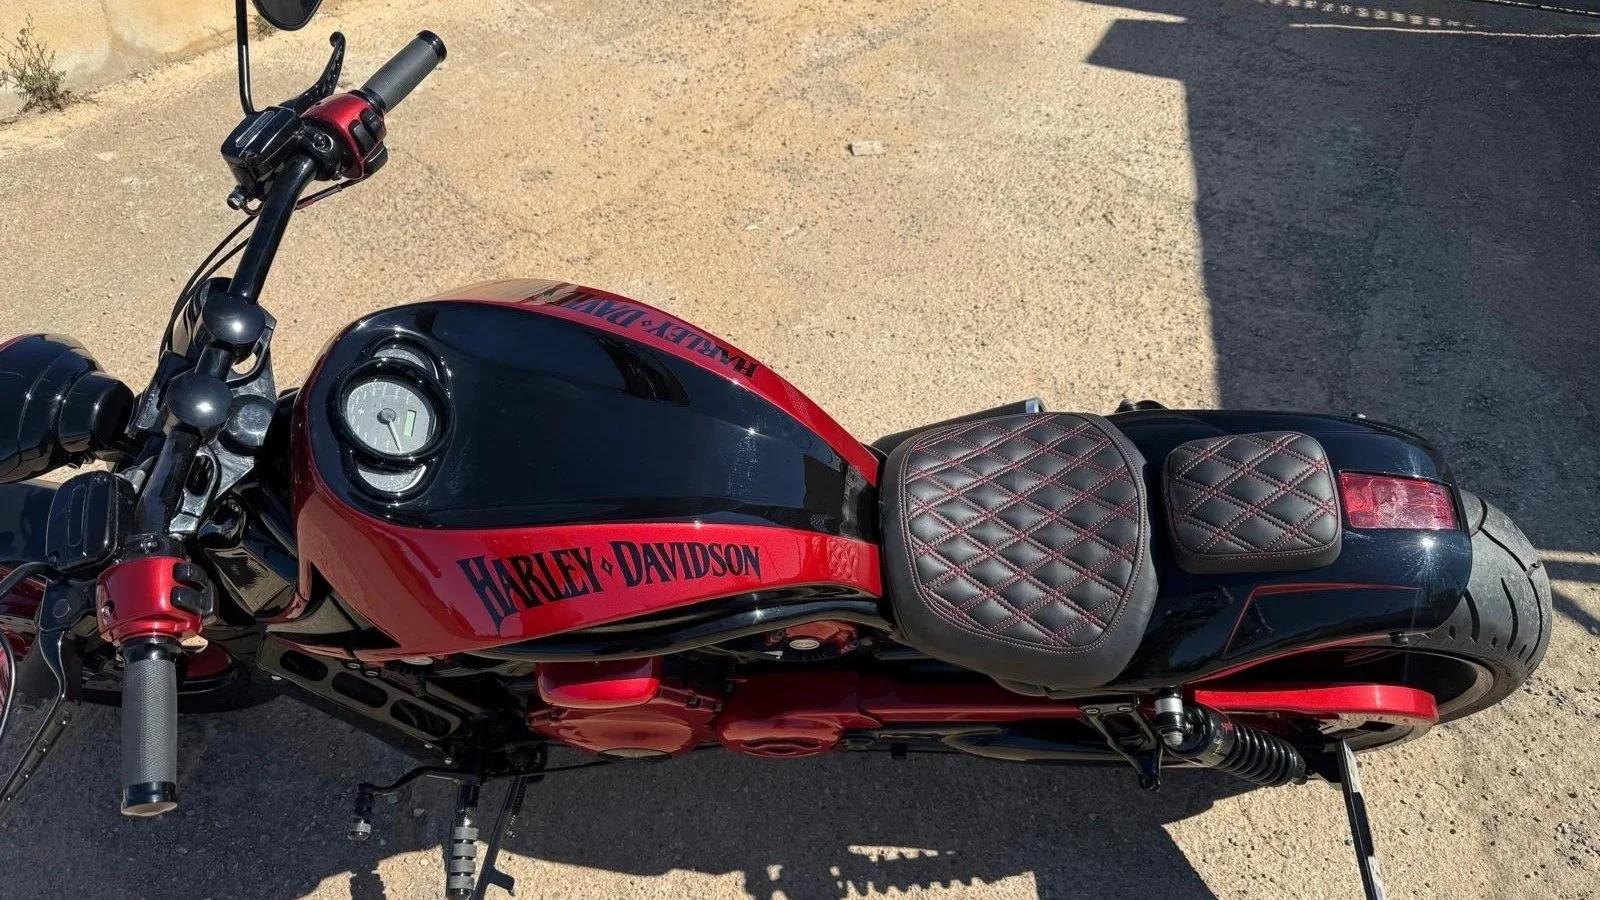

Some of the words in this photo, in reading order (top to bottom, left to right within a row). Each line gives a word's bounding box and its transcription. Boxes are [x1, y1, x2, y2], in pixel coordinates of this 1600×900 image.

[649, 321, 760, 378] HARLEY
[456, 546, 605, 636] HARLEY
[608, 540, 762, 588] DAVIDSON
